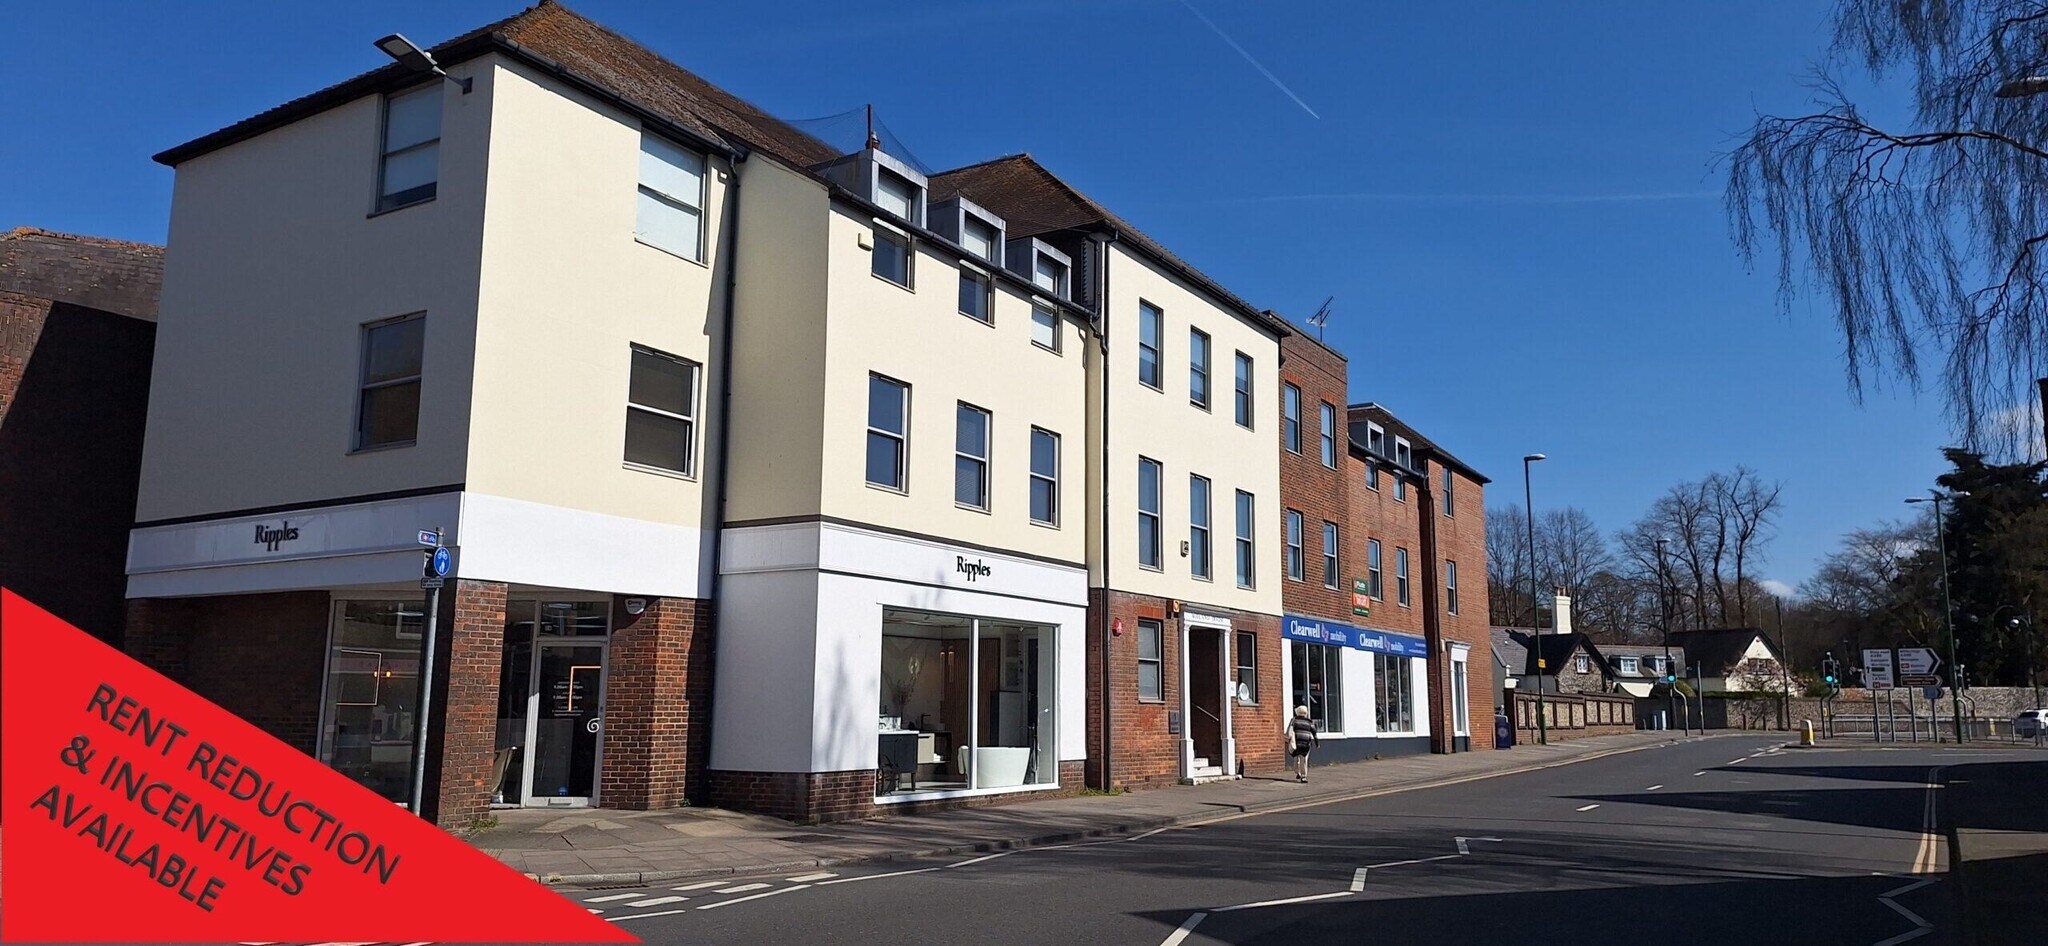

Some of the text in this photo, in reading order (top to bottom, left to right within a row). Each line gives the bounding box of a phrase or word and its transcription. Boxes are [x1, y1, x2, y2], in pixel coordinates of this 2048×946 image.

[254, 520, 299, 552] Ripples
[956, 555, 991, 582] Ripples
[1290, 619, 1321, 639] Clearwell
[1359, 633, 1384, 649] Clearwell
